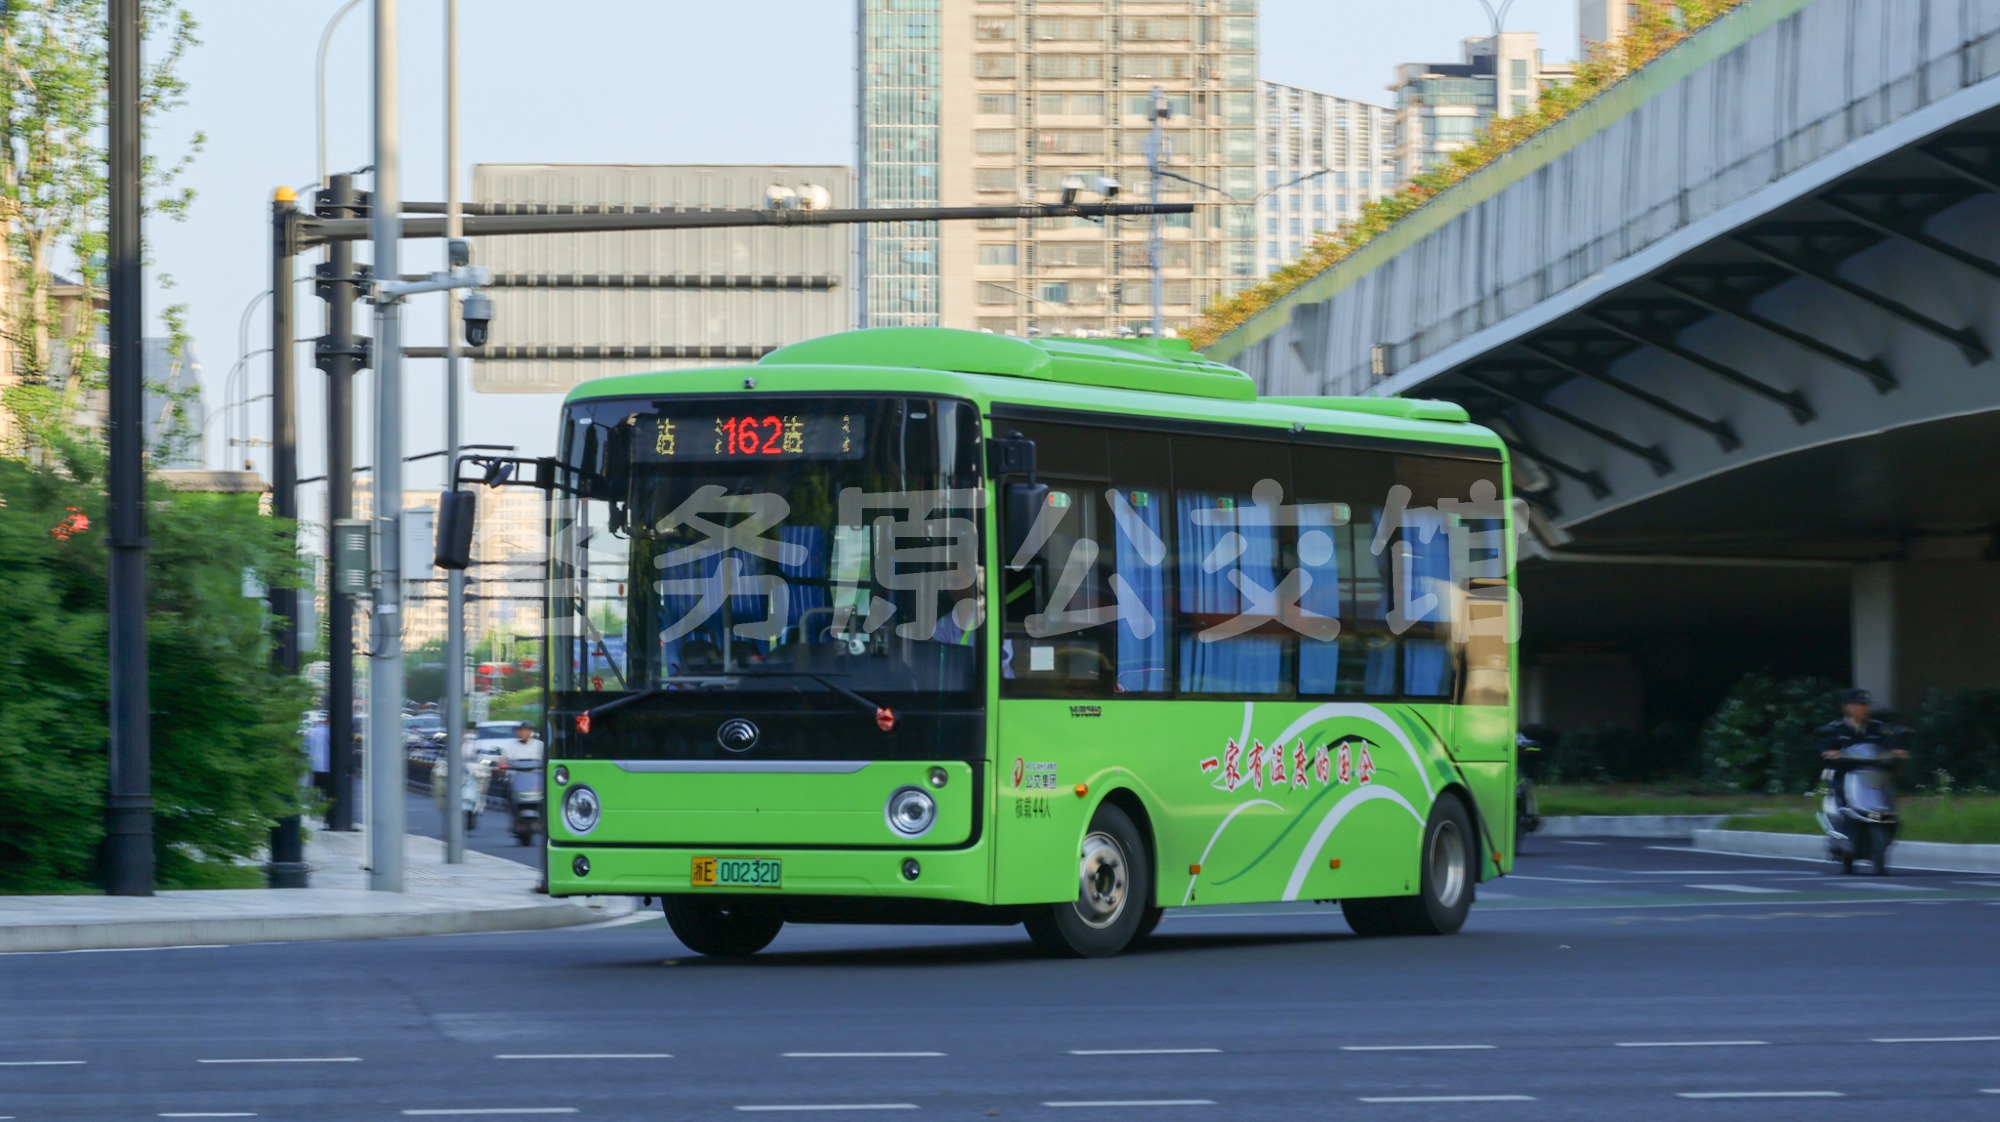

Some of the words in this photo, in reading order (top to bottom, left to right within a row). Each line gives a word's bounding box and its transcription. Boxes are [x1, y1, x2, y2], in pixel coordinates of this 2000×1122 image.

[723, 415, 783, 455] 162
[1025, 773, 1057, 790] 公交集团
